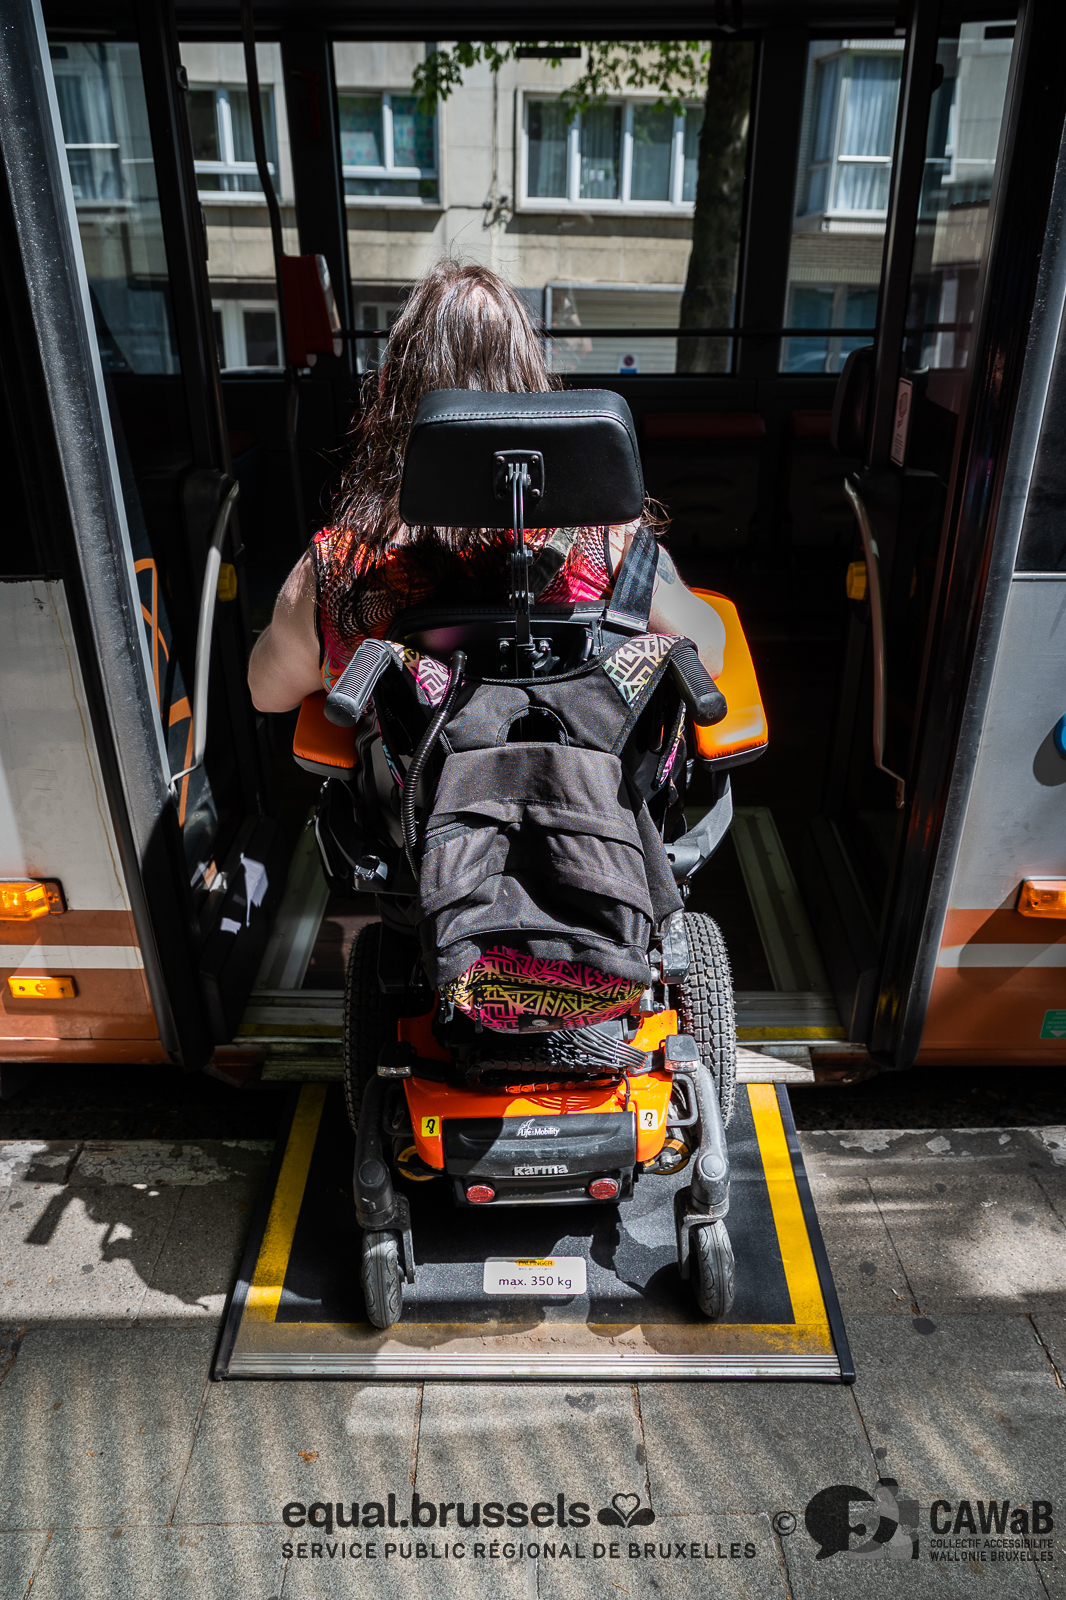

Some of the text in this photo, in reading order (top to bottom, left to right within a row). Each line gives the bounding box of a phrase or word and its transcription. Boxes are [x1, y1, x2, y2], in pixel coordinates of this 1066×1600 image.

[498, 1276, 572, 1289] max. 350 kg
